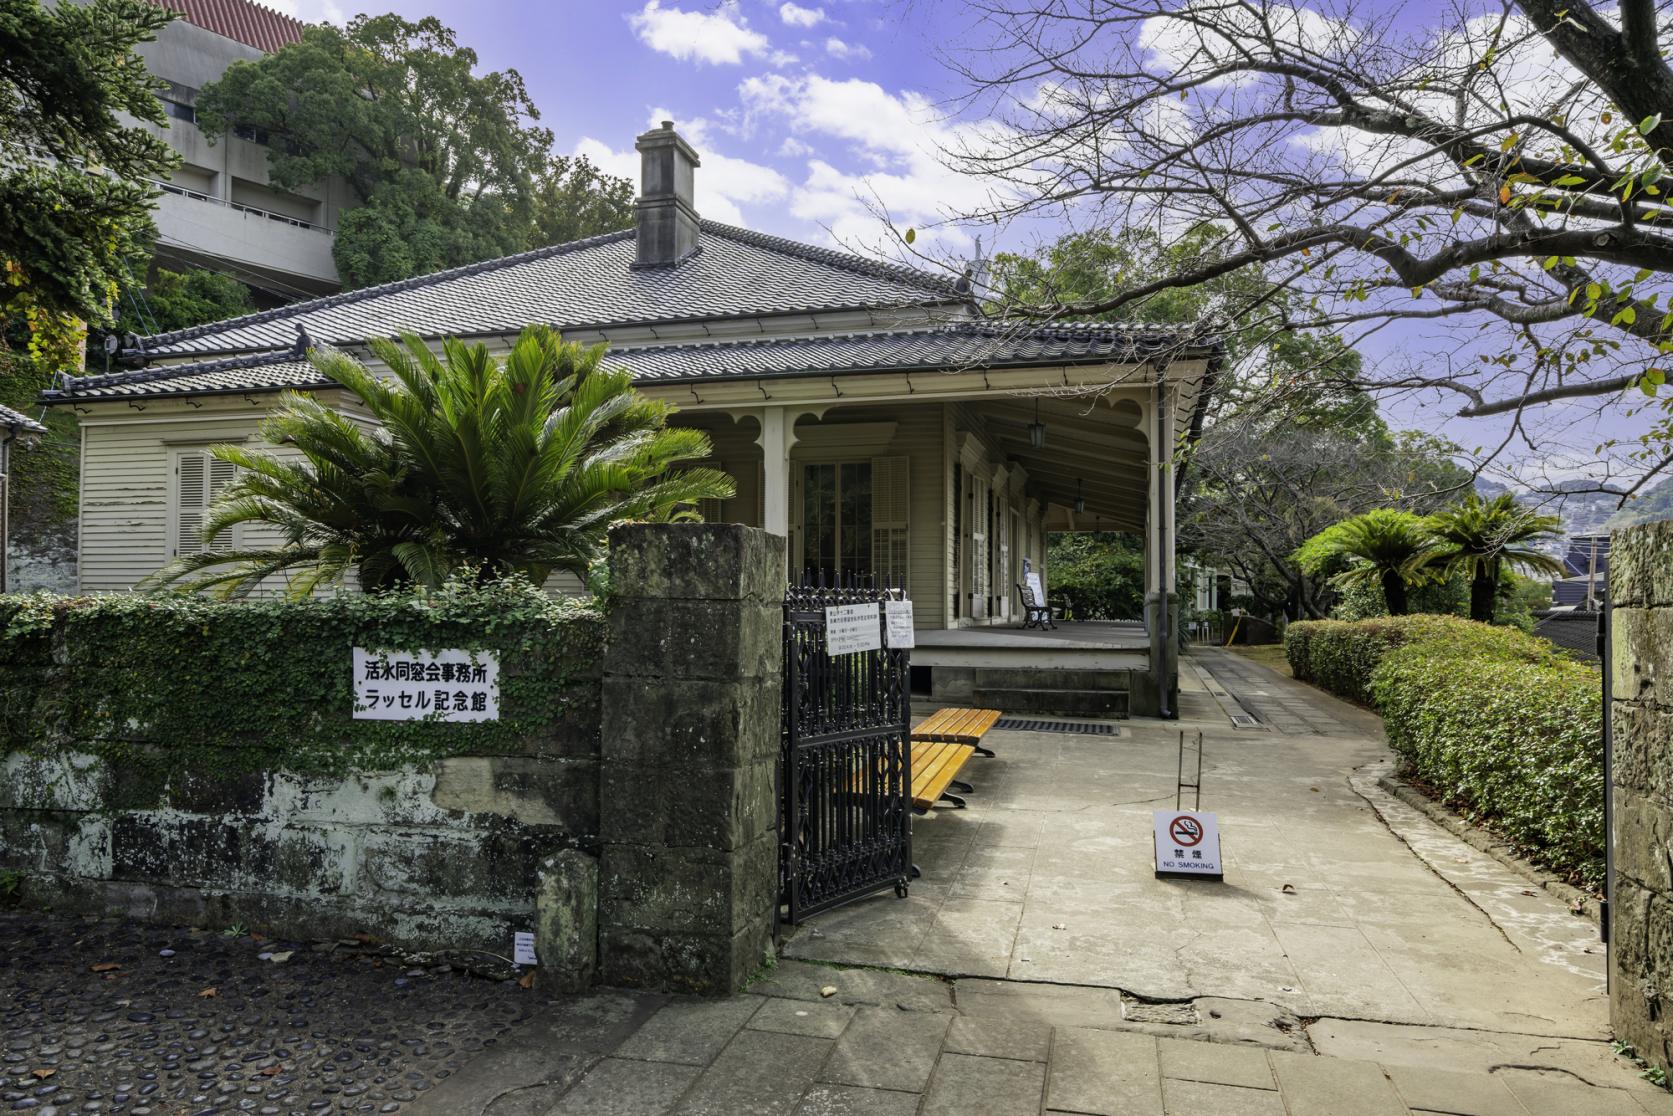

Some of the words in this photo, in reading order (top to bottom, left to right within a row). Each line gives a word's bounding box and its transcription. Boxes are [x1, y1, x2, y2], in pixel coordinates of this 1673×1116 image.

[365, 660, 488, 684] 活水同窓会事務所
[365, 689, 488, 712] ラッセル記念館
[1178, 861, 1214, 870] SMOKING
